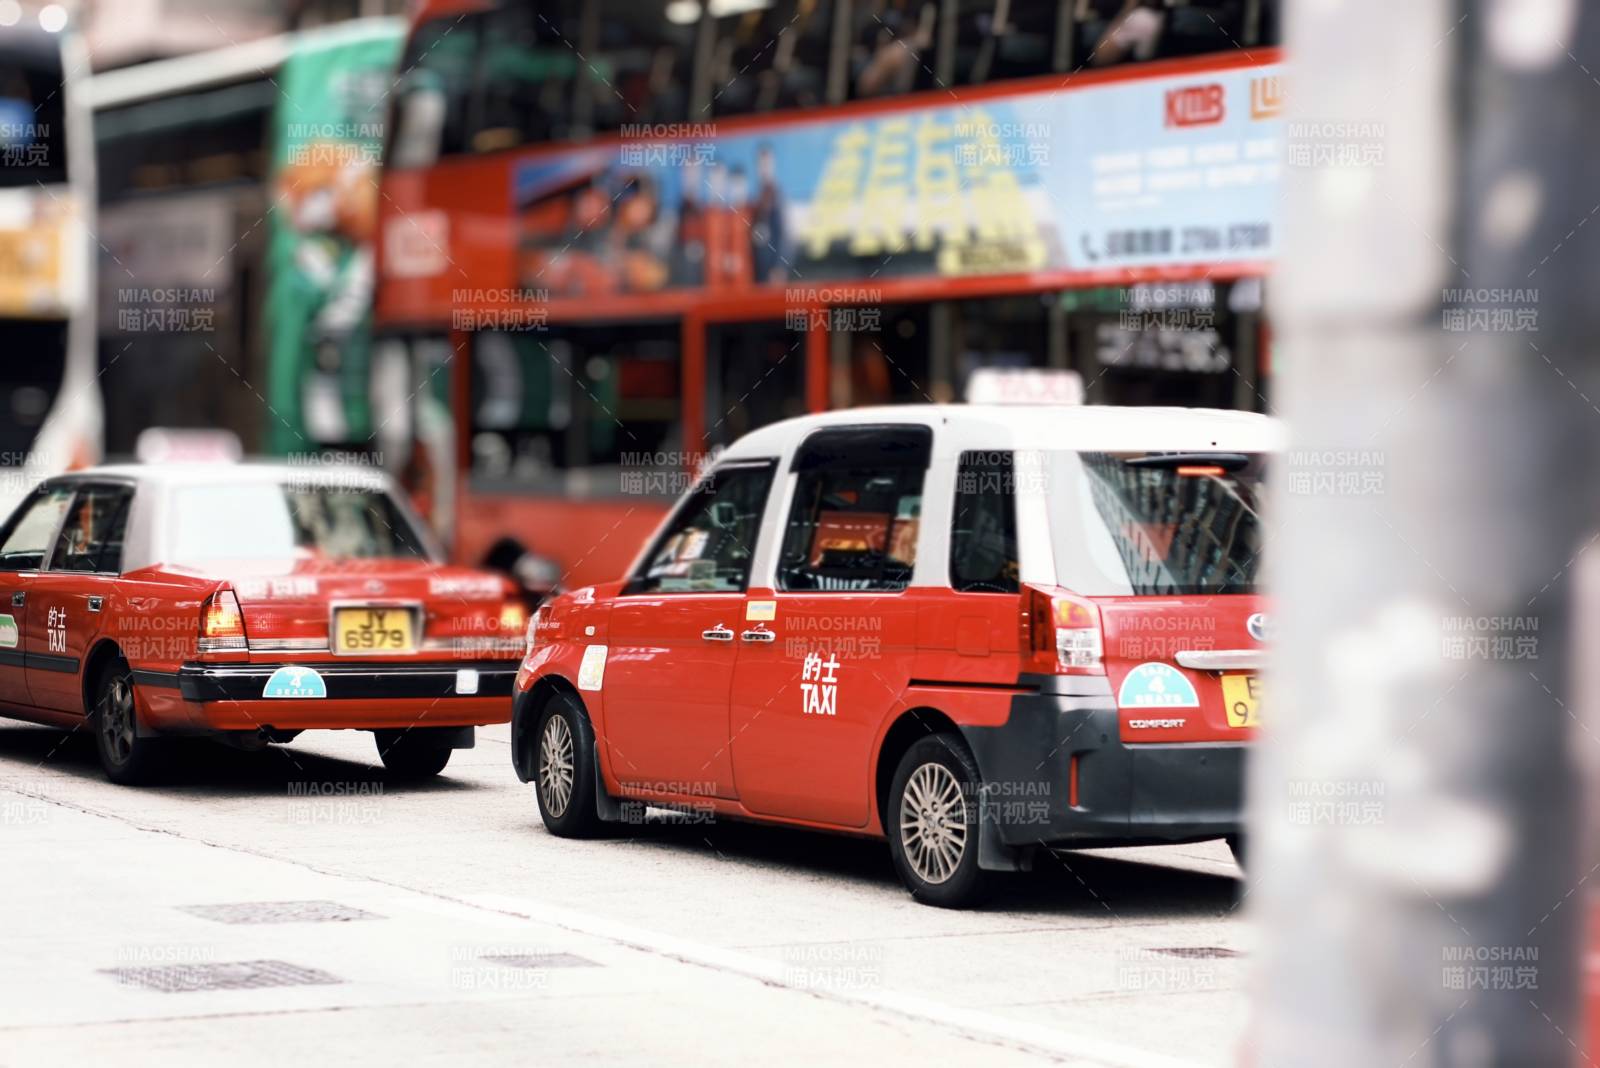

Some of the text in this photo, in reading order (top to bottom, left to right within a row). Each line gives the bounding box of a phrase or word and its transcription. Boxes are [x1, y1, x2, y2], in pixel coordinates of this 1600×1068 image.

[47, 606, 67, 628] 的士
[359, 611, 386, 630] JY
[47, 630, 66, 652] TAXI
[345, 630, 404, 648] 6979
[802, 652, 840, 683] 的士
[289, 674, 302, 688] 4
[276, 688, 314, 696] SEATS
[800, 684, 837, 715] TAXI
[1129, 719, 1186, 729] COMFORT
